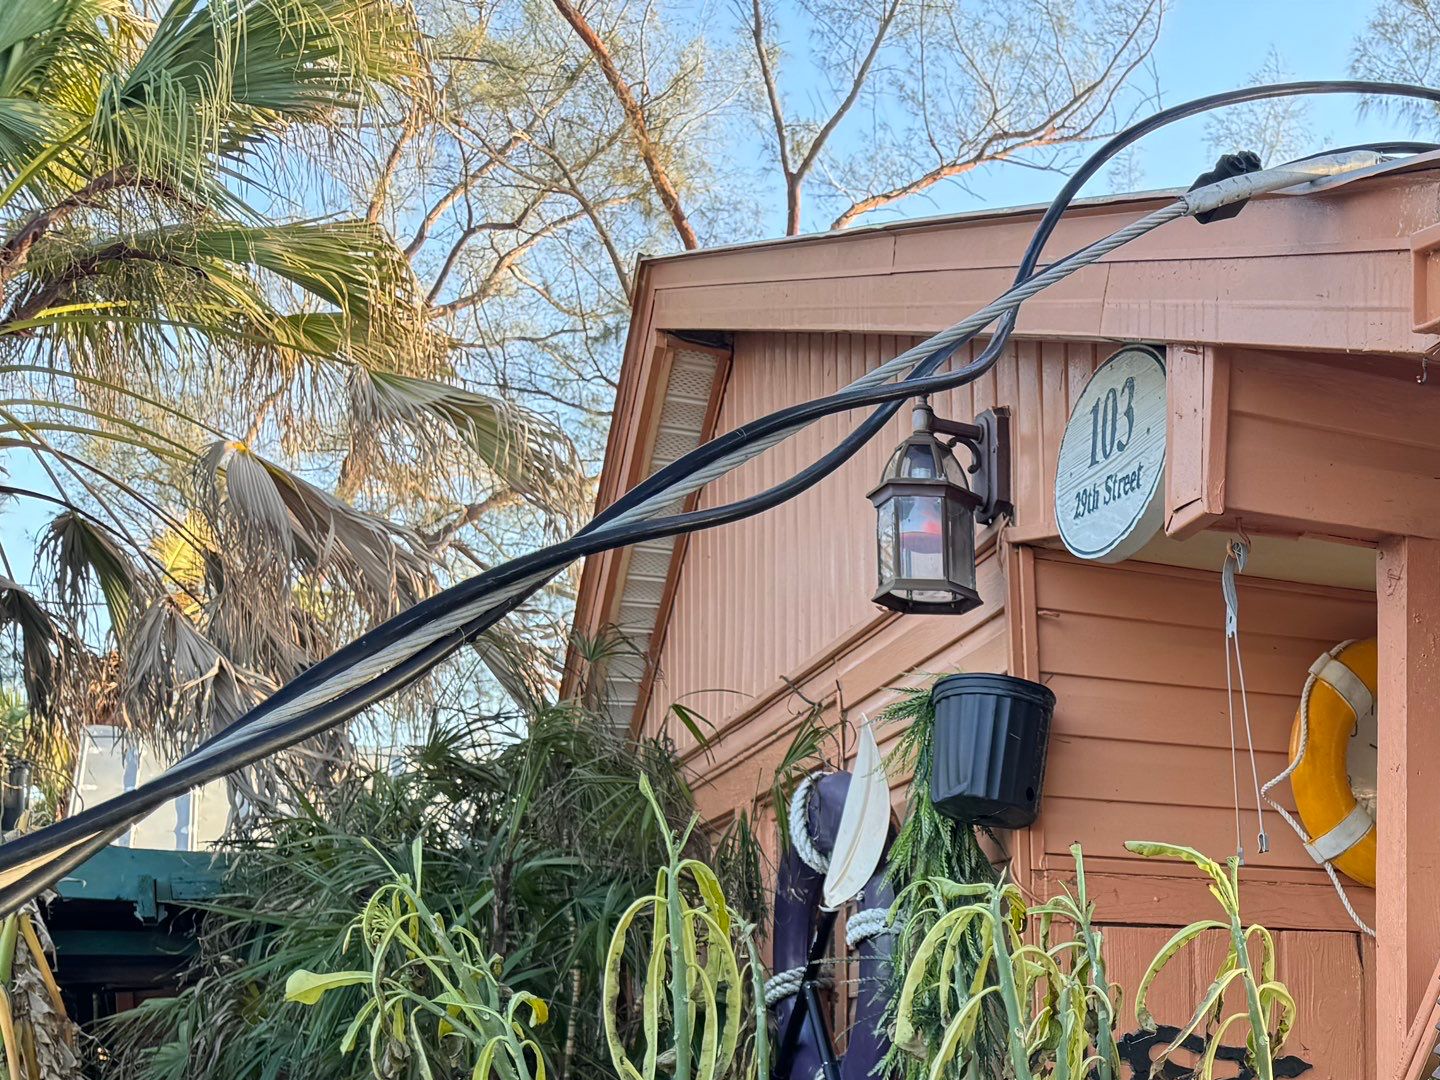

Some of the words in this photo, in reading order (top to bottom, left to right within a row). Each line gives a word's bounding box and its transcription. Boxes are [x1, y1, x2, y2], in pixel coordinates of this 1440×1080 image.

[1088, 376, 1136, 469] 103
[1073, 483, 1100, 520] 29th
[1103, 461, 1145, 506] Street
